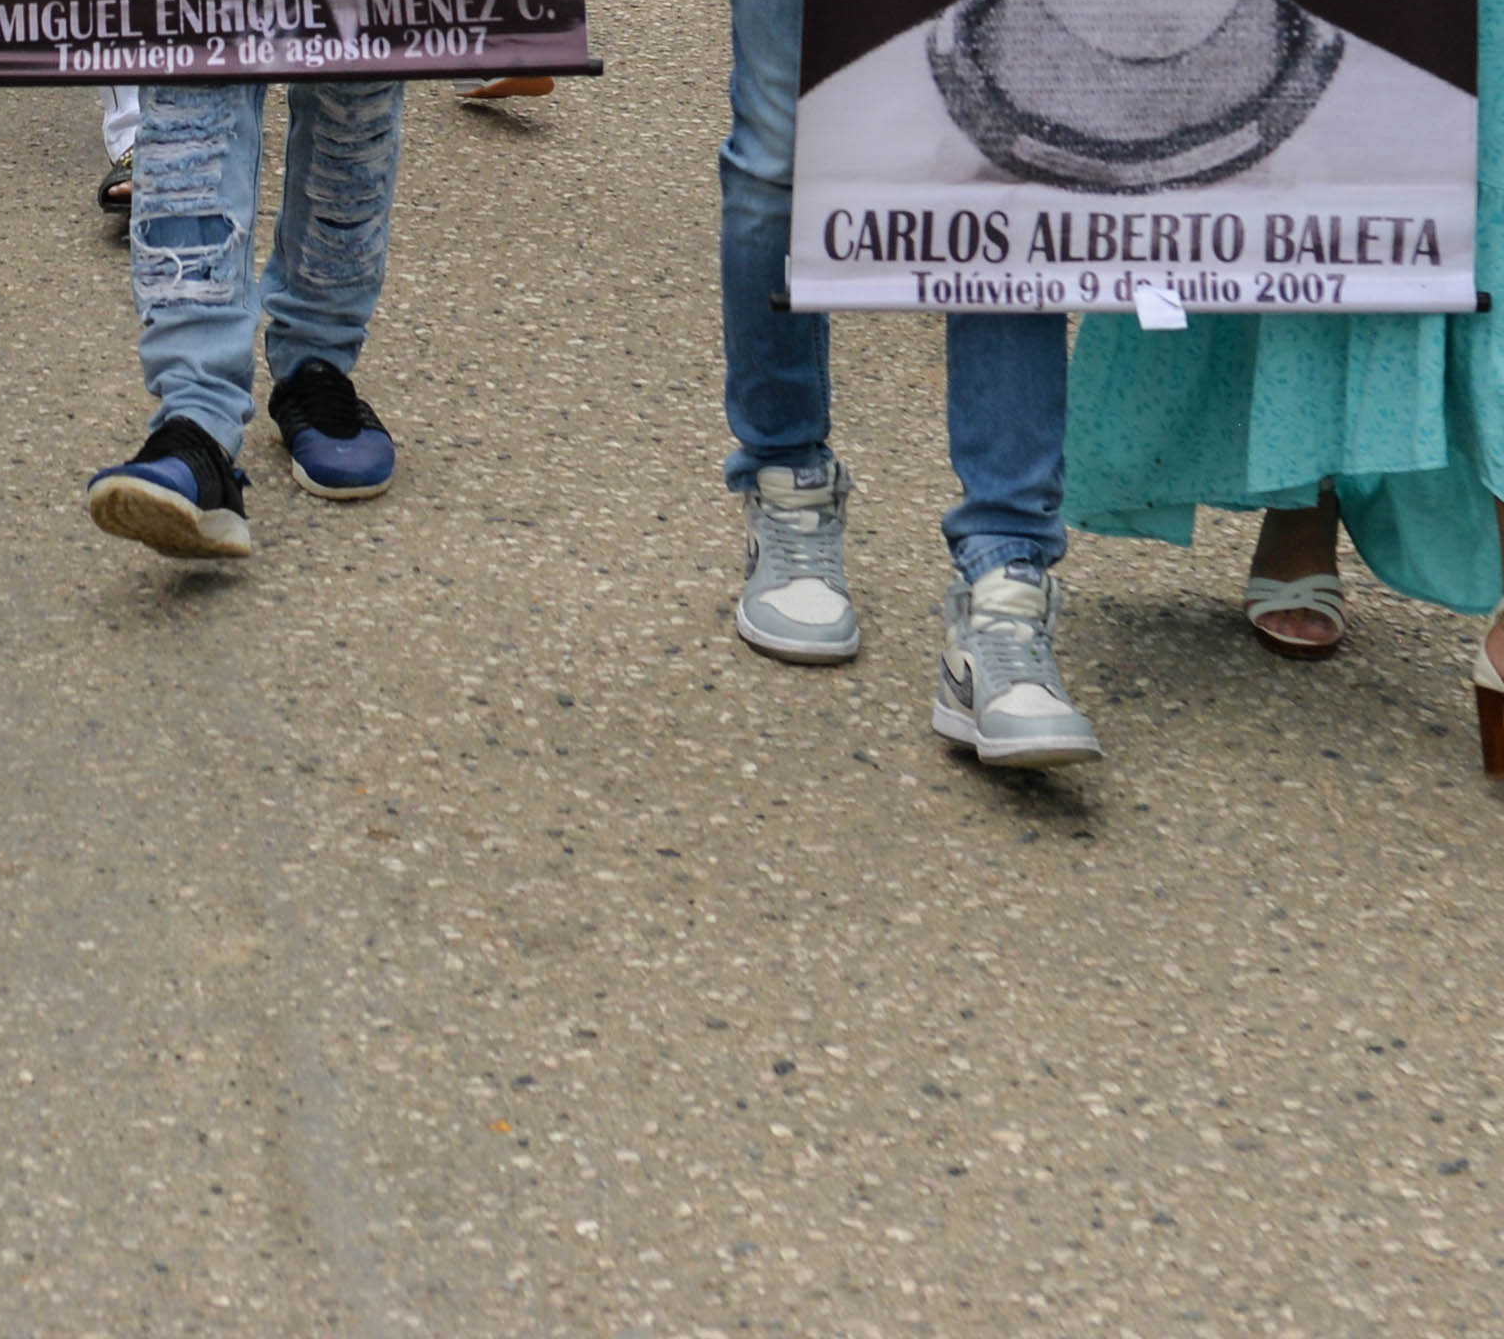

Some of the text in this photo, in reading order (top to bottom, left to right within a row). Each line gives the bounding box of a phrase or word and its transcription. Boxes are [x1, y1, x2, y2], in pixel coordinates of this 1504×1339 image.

[54, 26, 488, 74] Tolúviejo 2 de agosto 2007
[823, 208, 1442, 268] CARLOS ALBERTO BALETA
[911, 269, 1068, 310] Tolúviejo
[1078, 271, 1101, 304] 9
[1254, 271, 1347, 305] 2007
